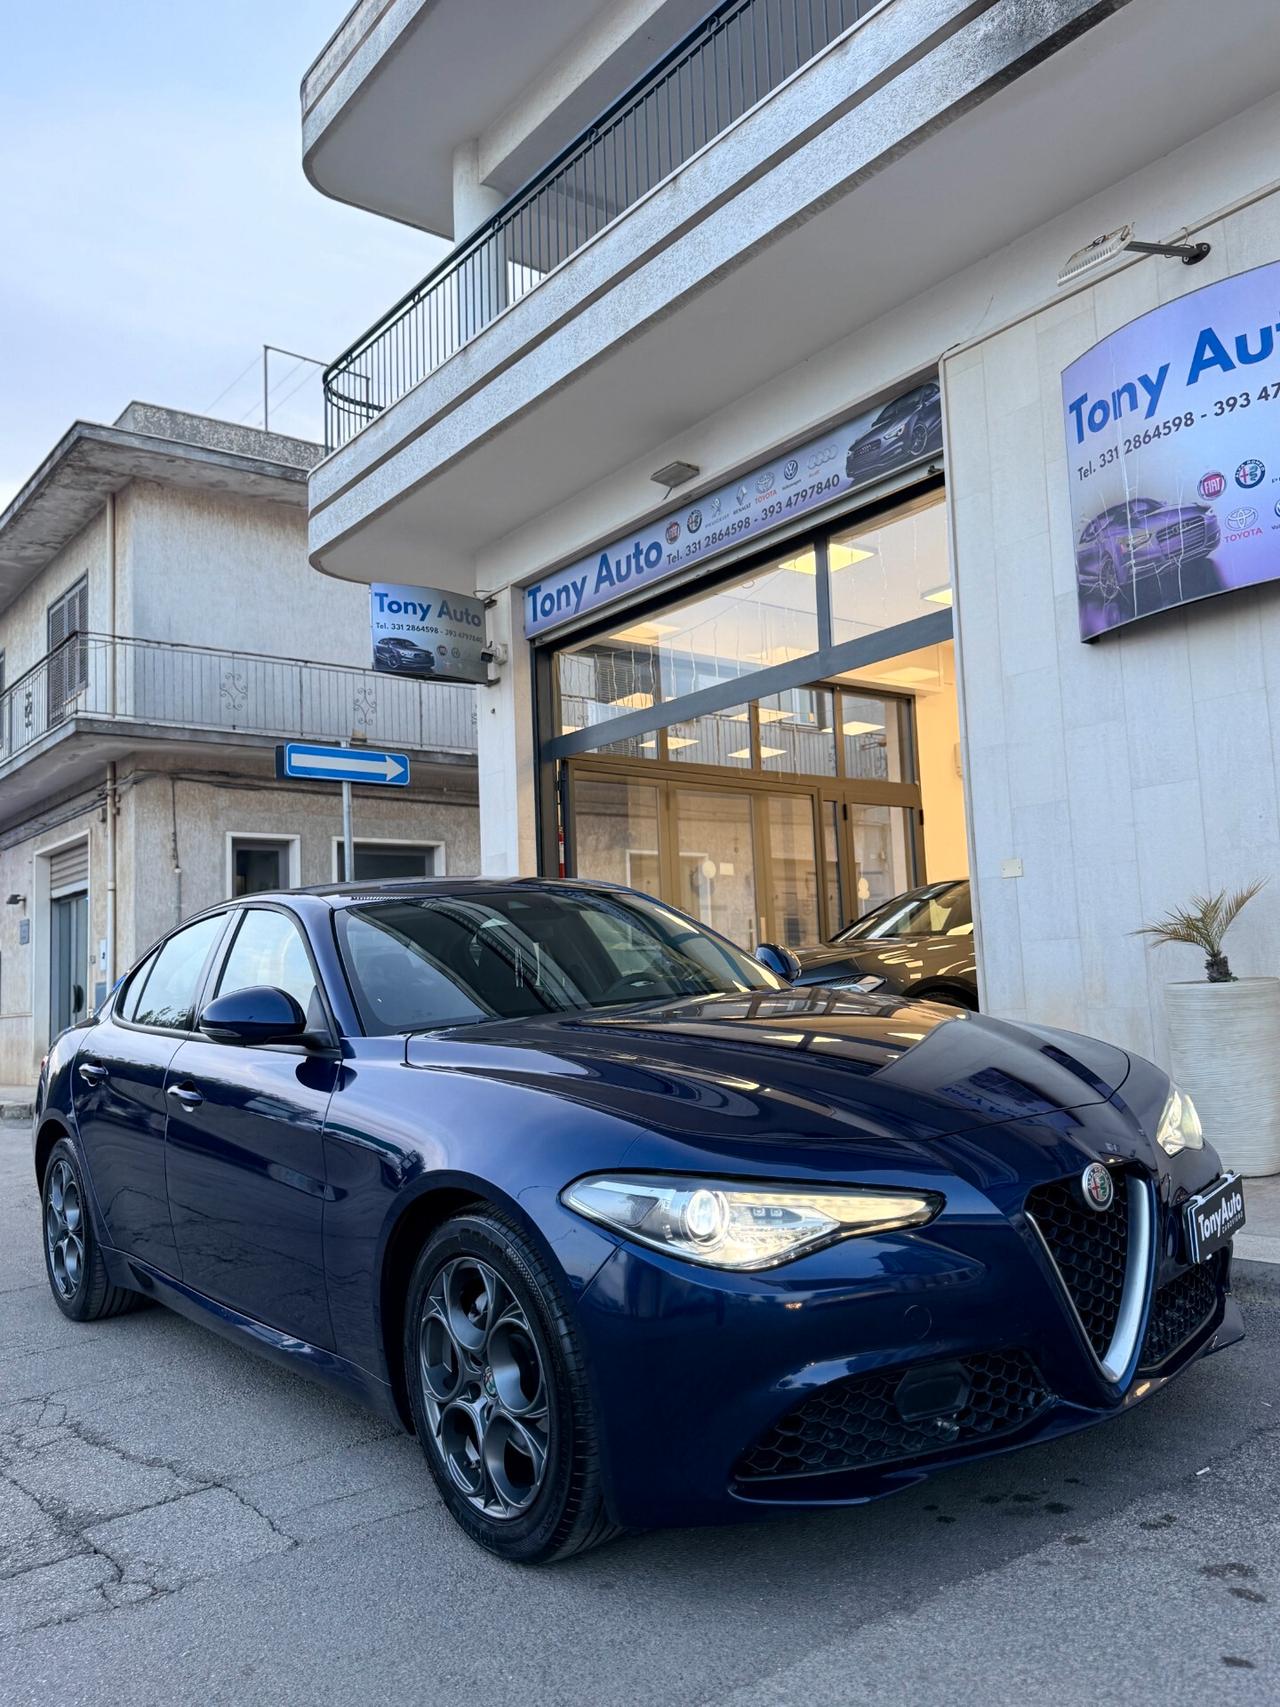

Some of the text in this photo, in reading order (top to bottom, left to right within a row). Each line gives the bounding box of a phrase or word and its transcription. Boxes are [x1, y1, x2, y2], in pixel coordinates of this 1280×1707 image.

[1069, 362, 1171, 444] Tony
[1077, 461, 1095, 481] Tel.
[1099, 446, 1120, 470] 331
[1123, 411, 1195, 455] 2864598
[1213, 391, 1250, 419] 393
[755, 489, 777, 505] TOYOTA
[1204, 478, 1221, 494] FIAT
[666, 552, 683, 566] Tel.
[685, 541, 702, 557] 331
[704, 517, 751, 549] 2864598
[761, 502, 783, 521] 393
[785, 473, 840, 509] 4797840
[1225, 528, 1263, 543] TOYOTA
[528, 541, 662, 622] Tony Auto
[374, 593, 482, 627] Tony Auto
[376, 622, 389, 630] Tel.
[391, 623, 404, 631] 331
[406, 625, 439, 634] 2864598
[1198, 1192, 1242, 1241] TonyAuto
